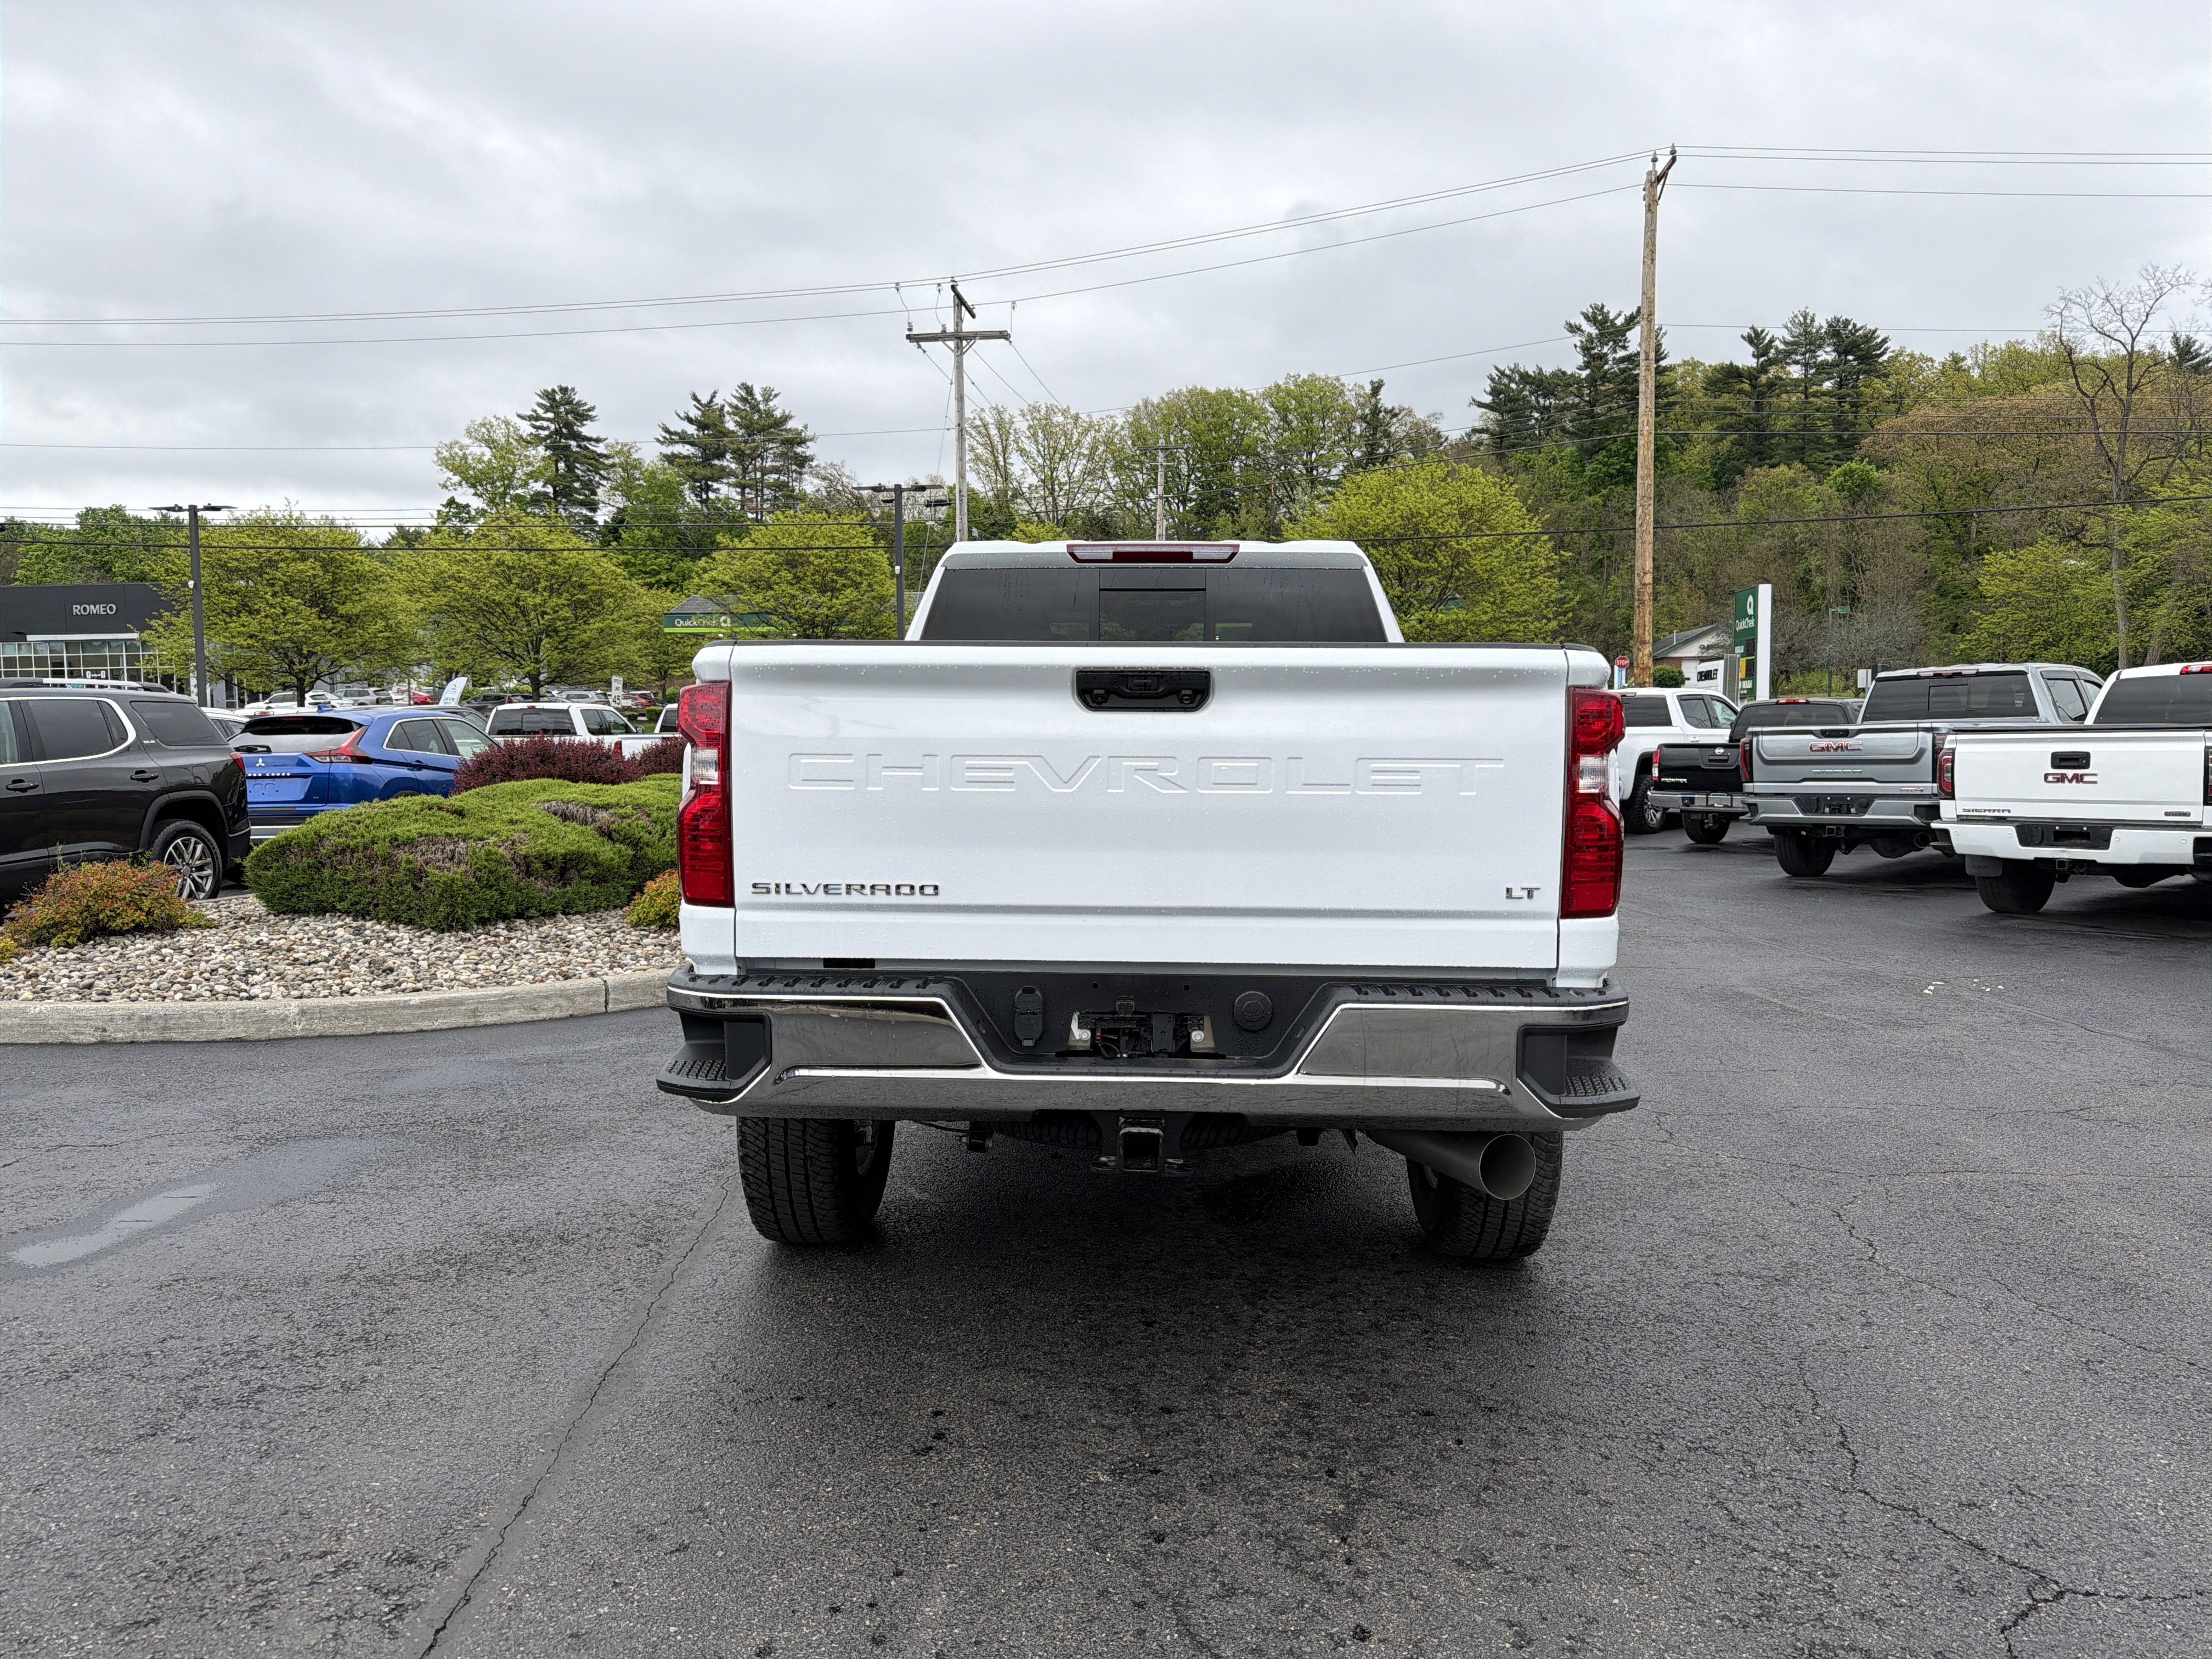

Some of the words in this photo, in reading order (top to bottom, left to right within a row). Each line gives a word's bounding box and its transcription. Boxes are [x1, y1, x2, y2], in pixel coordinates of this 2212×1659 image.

[72, 604, 116, 615] ROMEO
[1735, 616, 1755, 632] QuickChek
[613, 695, 621, 705] 45
[1809, 741, 1863, 752] GMC
[789, 754, 1505, 796] CHEVROLET
[2044, 772, 2098, 785] GMC
[752, 882, 940, 896] SILVERADO
[1505, 886, 1541, 900] LT
